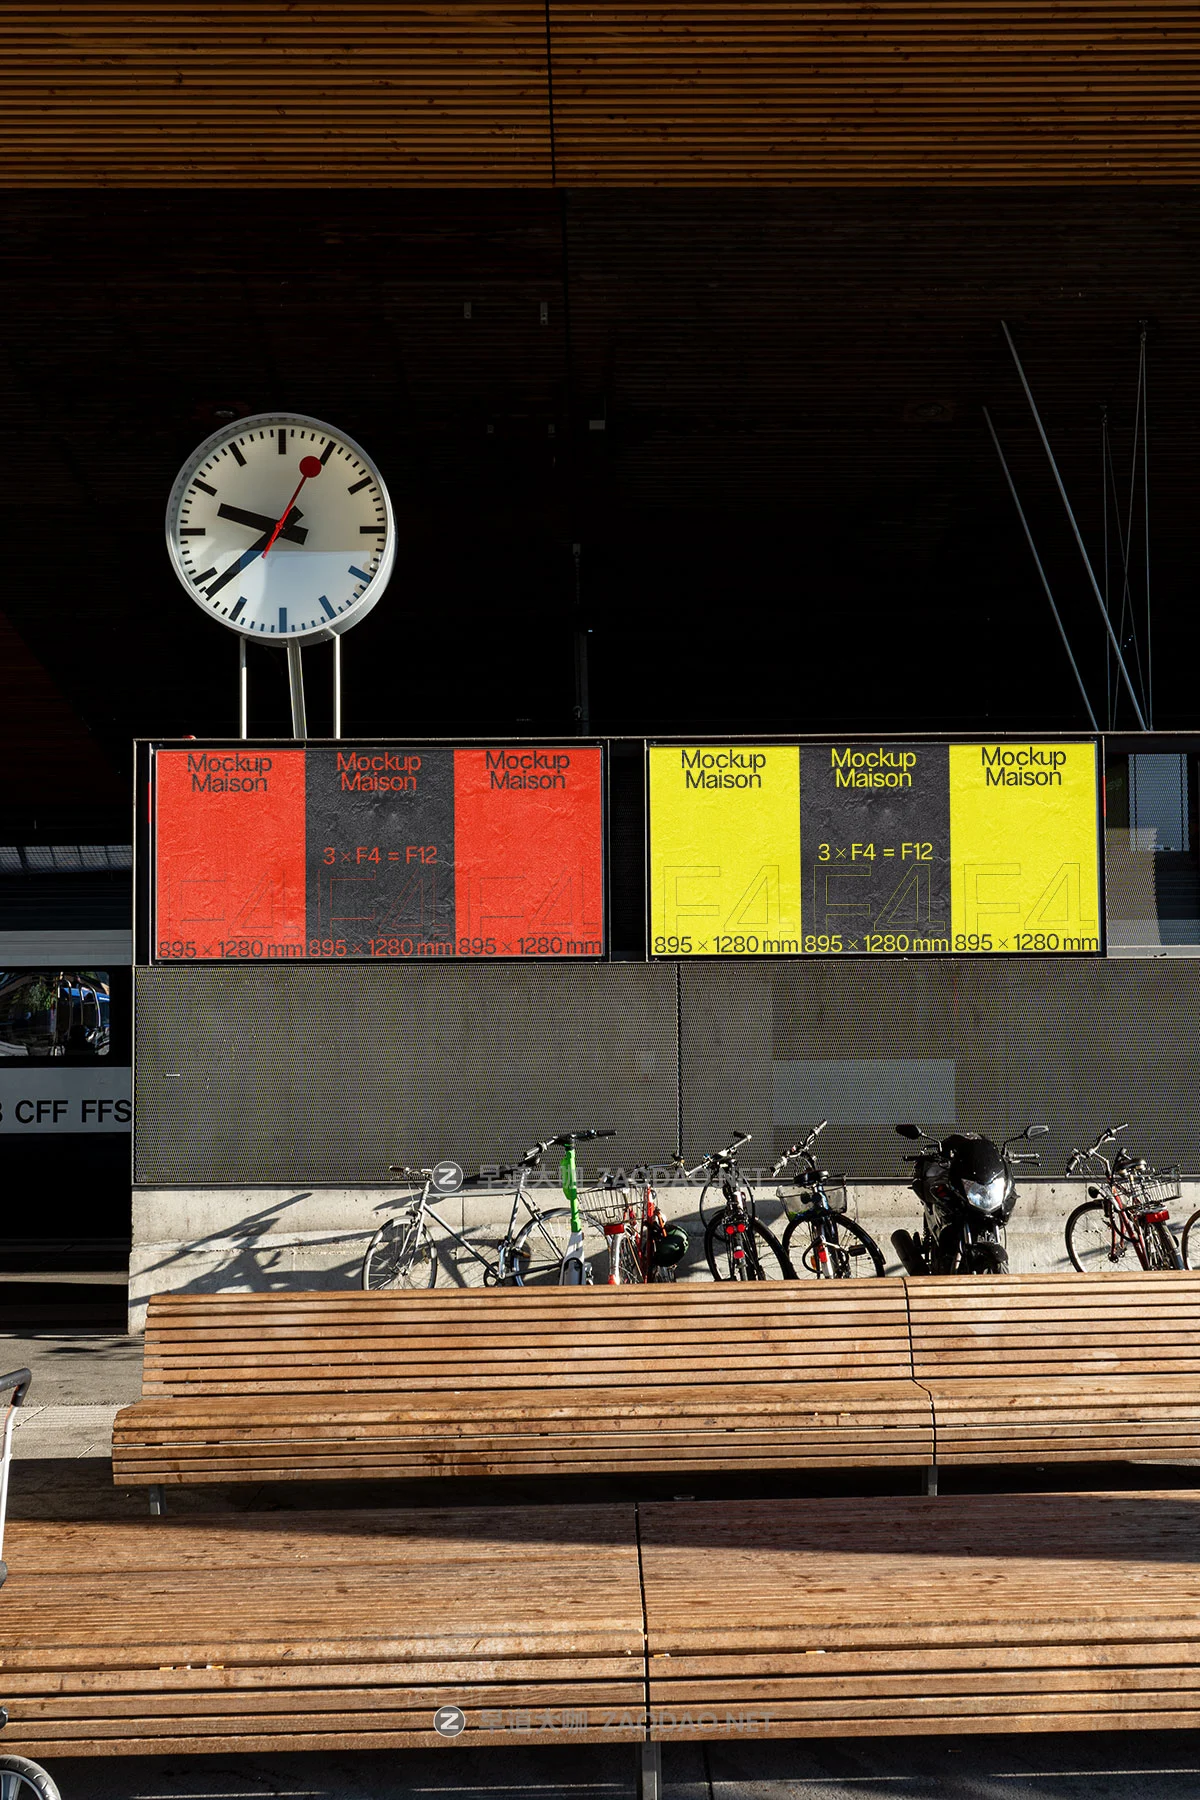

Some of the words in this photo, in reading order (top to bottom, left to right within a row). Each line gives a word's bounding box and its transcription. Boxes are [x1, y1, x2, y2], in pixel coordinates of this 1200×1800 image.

[187, 753, 272, 776] Mockup
[336, 751, 422, 774] Mockup
[485, 750, 570, 772] Mockup
[681, 749, 767, 773] Mockup
[831, 748, 917, 771] Mockup
[981, 746, 1067, 770] Mockup
[191, 773, 268, 793] Maison
[341, 772, 417, 791] Maison
[490, 770, 566, 790] Maison
[685, 769, 762, 789] Maison
[835, 768, 912, 788] Maison
[985, 767, 1062, 786] Maison
[323, 847, 336, 865] 3
[356, 846, 382, 865] F4
[405, 845, 438, 864] F12
[818, 843, 831, 861] 3
[851, 843, 877, 861] F4
[901, 842, 934, 861] F12
[663, 864, 796, 953] F4
[813, 863, 946, 951] F4
[963, 862, 1096, 950] F4
[159, 941, 197, 958] 895
[217, 940, 264, 957] 1280
[267, 944, 303, 957] mm
[309, 939, 347, 956] 895
[367, 938, 414, 956] 1280
[417, 942, 453, 955] mm
[459, 937, 497, 955] 895
[517, 937, 562, 954] 1280
[566, 940, 602, 954] mm
[654, 936, 693, 954] 895
[712, 935, 759, 953] 1280
[762, 939, 799, 953] mm
[804, 935, 843, 953] 895
[863, 934, 910, 952] 1280
[913, 938, 949, 951] mm
[955, 934, 993, 951] 895
[1013, 933, 1060, 950] 1280
[1063, 937, 1099, 950] mm
[15, 1100, 69, 1124] CFF
[81, 1100, 132, 1123] FFS
